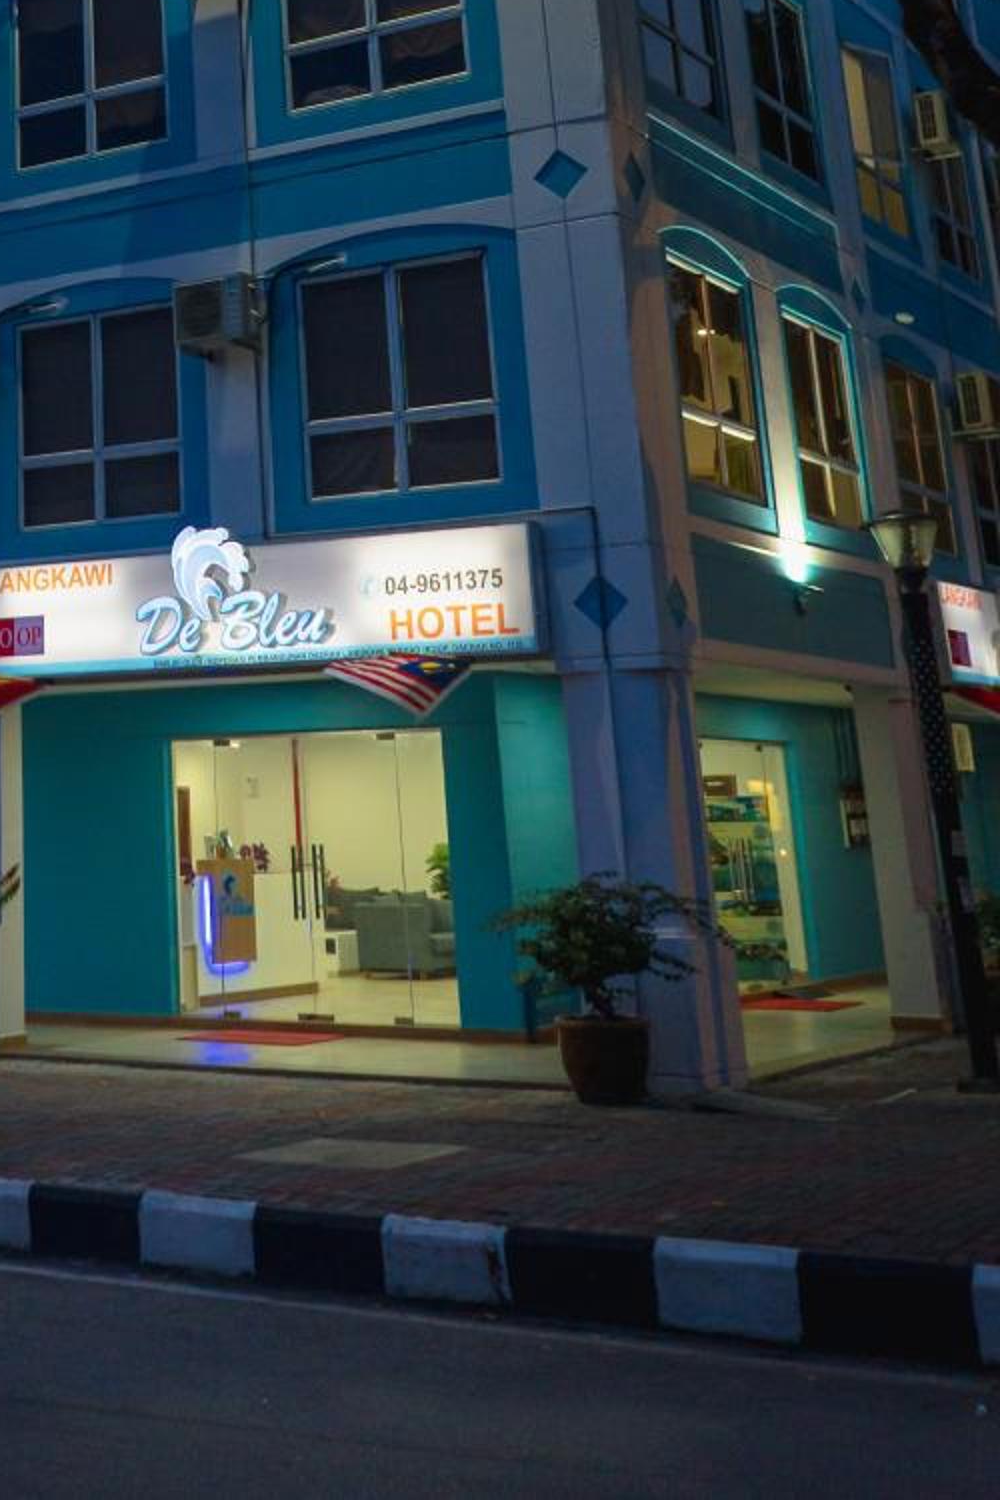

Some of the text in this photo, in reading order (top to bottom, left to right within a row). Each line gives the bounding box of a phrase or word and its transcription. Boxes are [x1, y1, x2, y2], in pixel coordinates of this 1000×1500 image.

[384, 567, 504, 595] 04-9611375
[135, 596, 202, 655] De
[219, 589, 331, 649] Bleu
[389, 602, 521, 640] HOTEL
